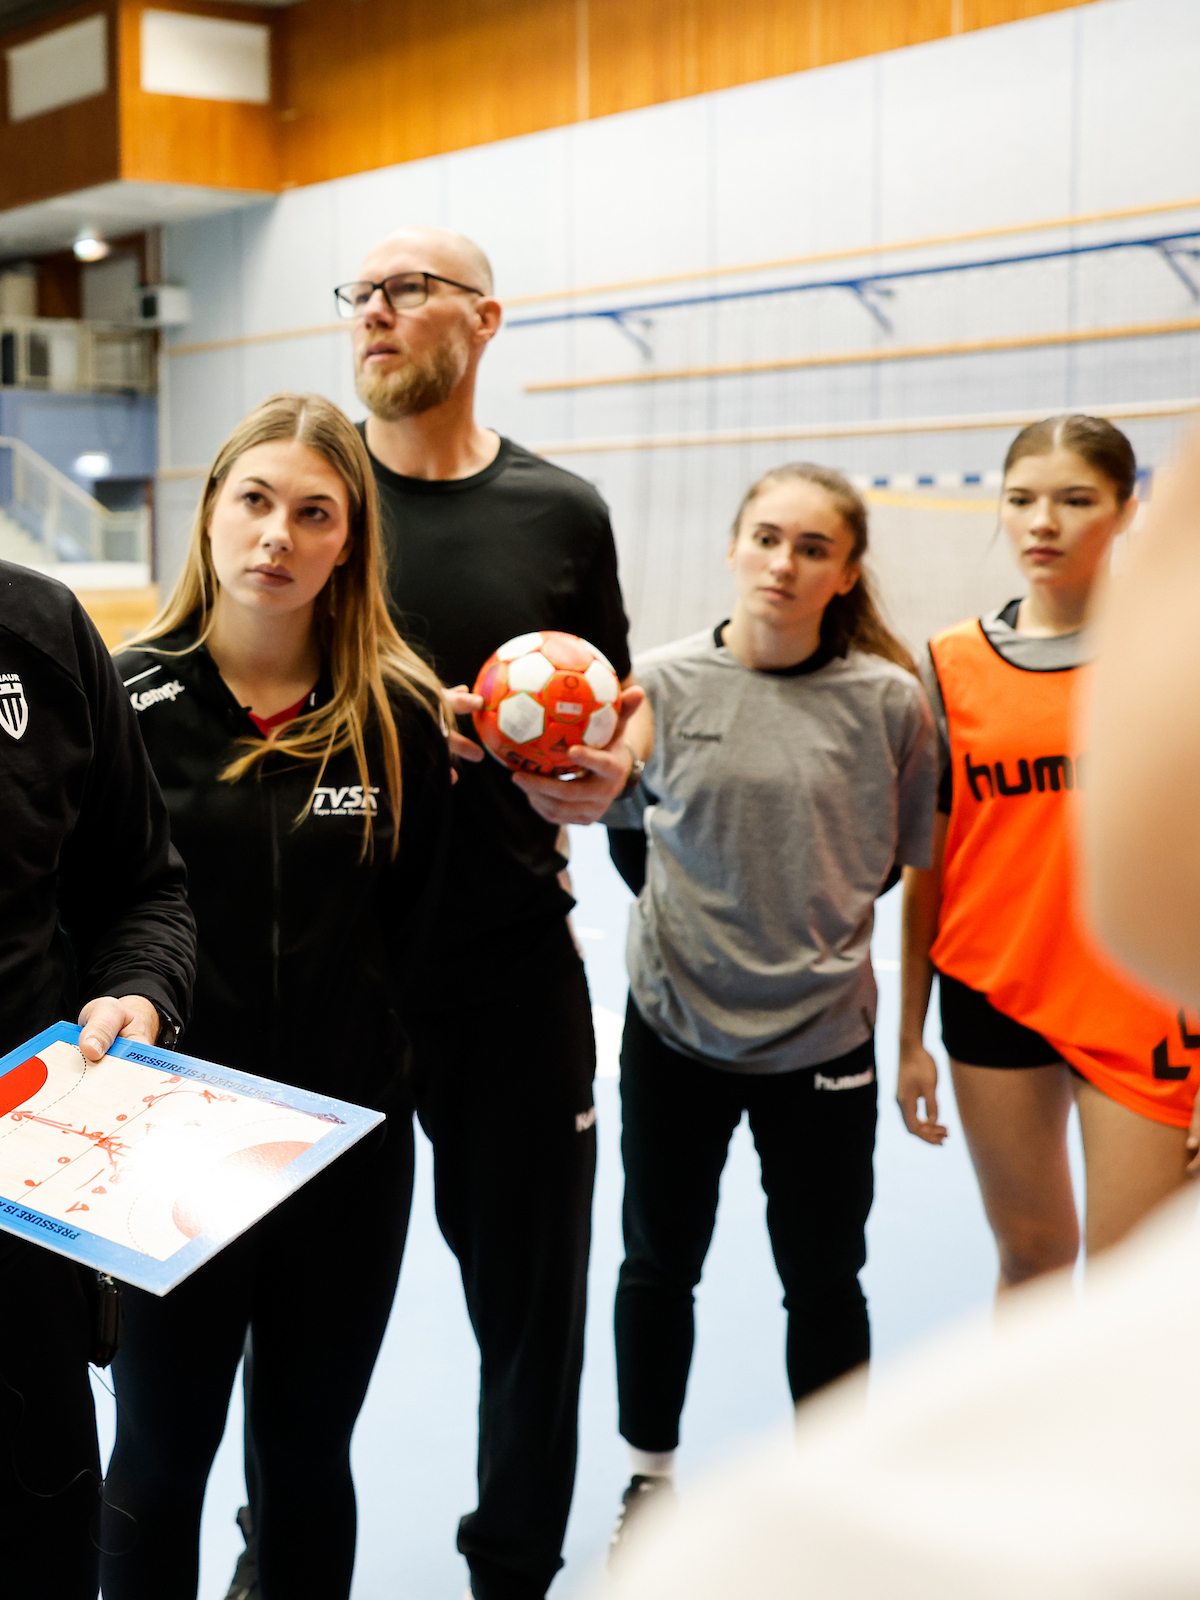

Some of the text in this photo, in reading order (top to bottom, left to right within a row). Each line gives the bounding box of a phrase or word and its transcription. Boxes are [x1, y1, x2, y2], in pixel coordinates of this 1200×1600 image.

[964, 752, 1088, 802] hum
[313, 785, 380, 809] TVSK
[126, 1051, 272, 1099] PRESSURE IS A PRIVILEGE
[3, 1203, 18, 1215] IS
[16, 1210, 81, 1240] PRESSURE
